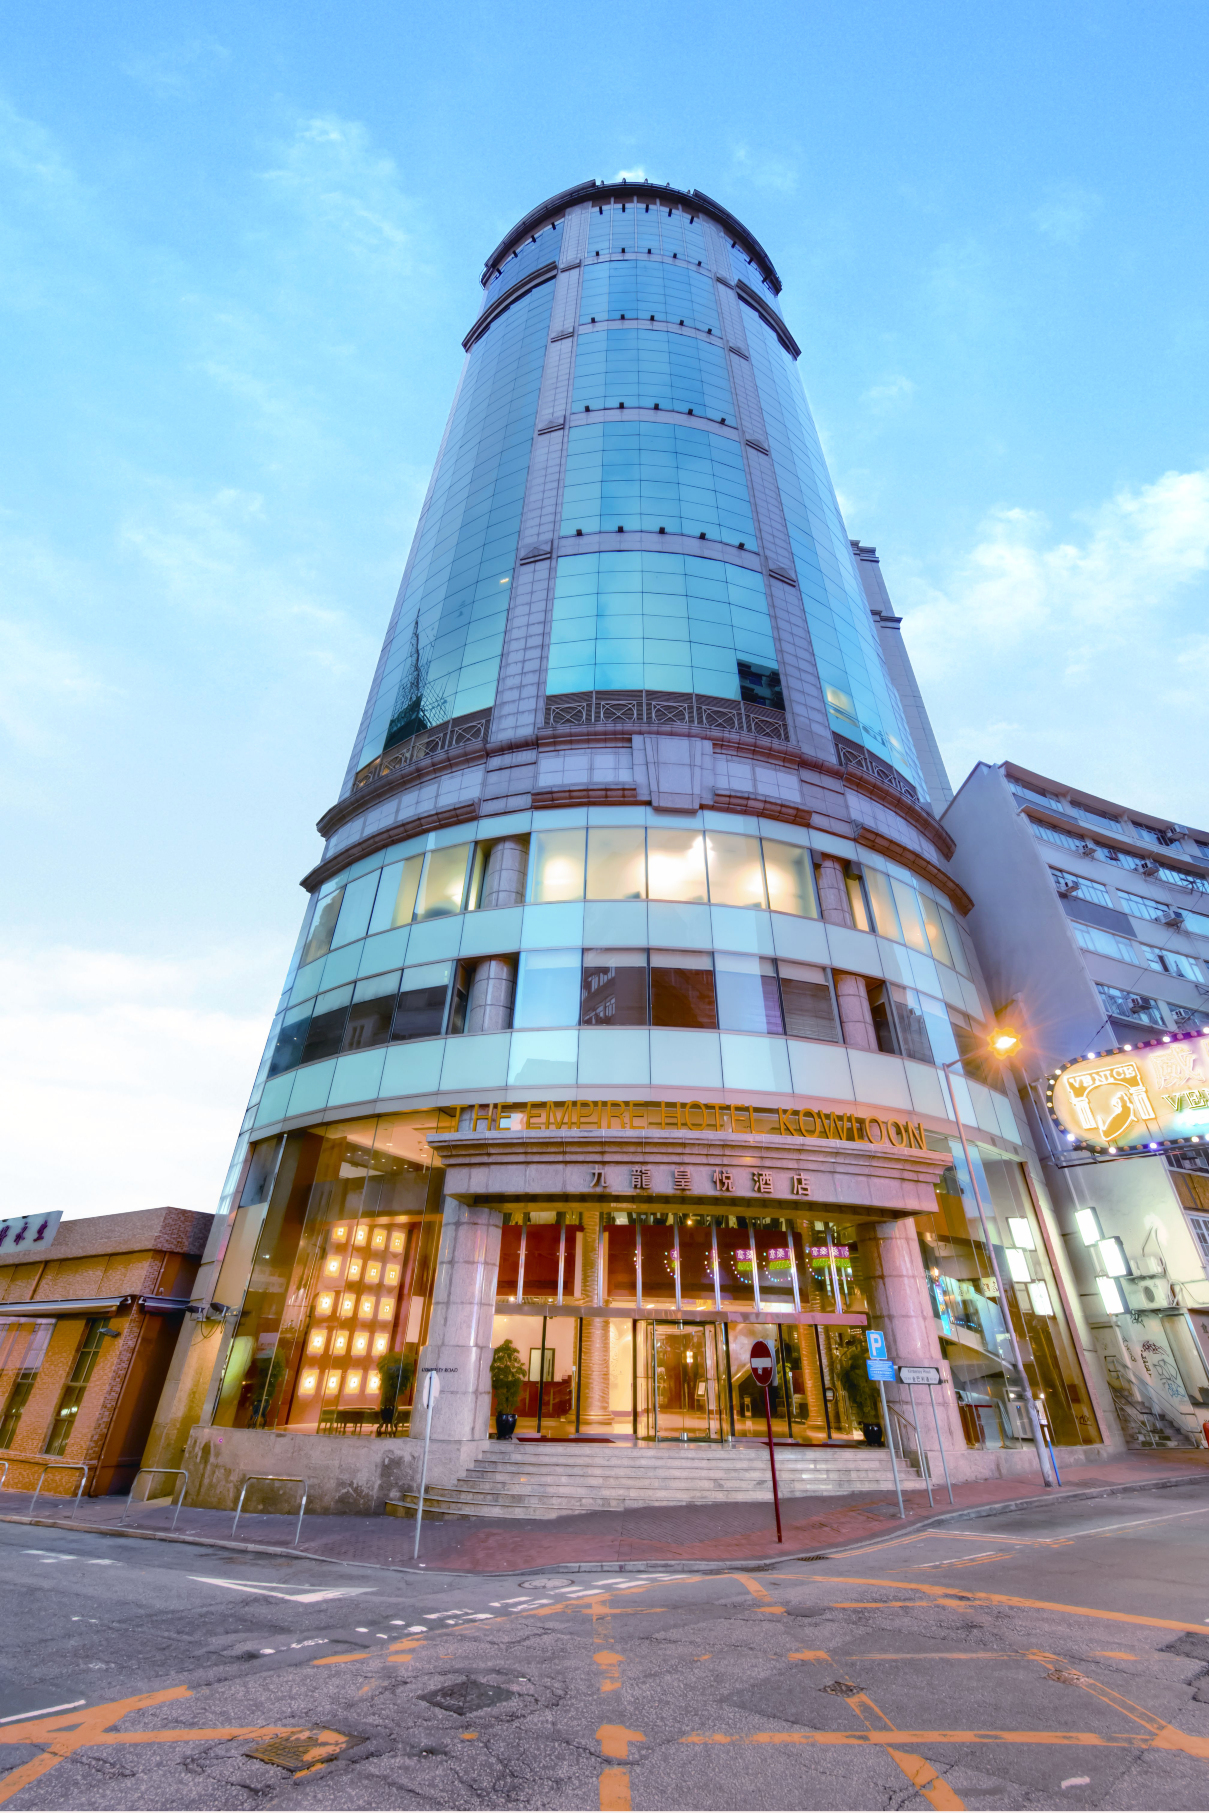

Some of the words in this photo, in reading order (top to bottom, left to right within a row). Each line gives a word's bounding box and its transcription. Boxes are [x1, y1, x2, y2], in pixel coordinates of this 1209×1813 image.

[1069, 1065, 1136, 1088] VENICE
[1161, 1089, 1209, 1112] VE
[450, 1102, 513, 1133] THE
[526, 1100, 645, 1130] EMPIRE
[661, 1100, 766, 1134] HOTEL
[778, 1107, 927, 1150] KOWLOON
[870, 1334, 882, 1356] P
